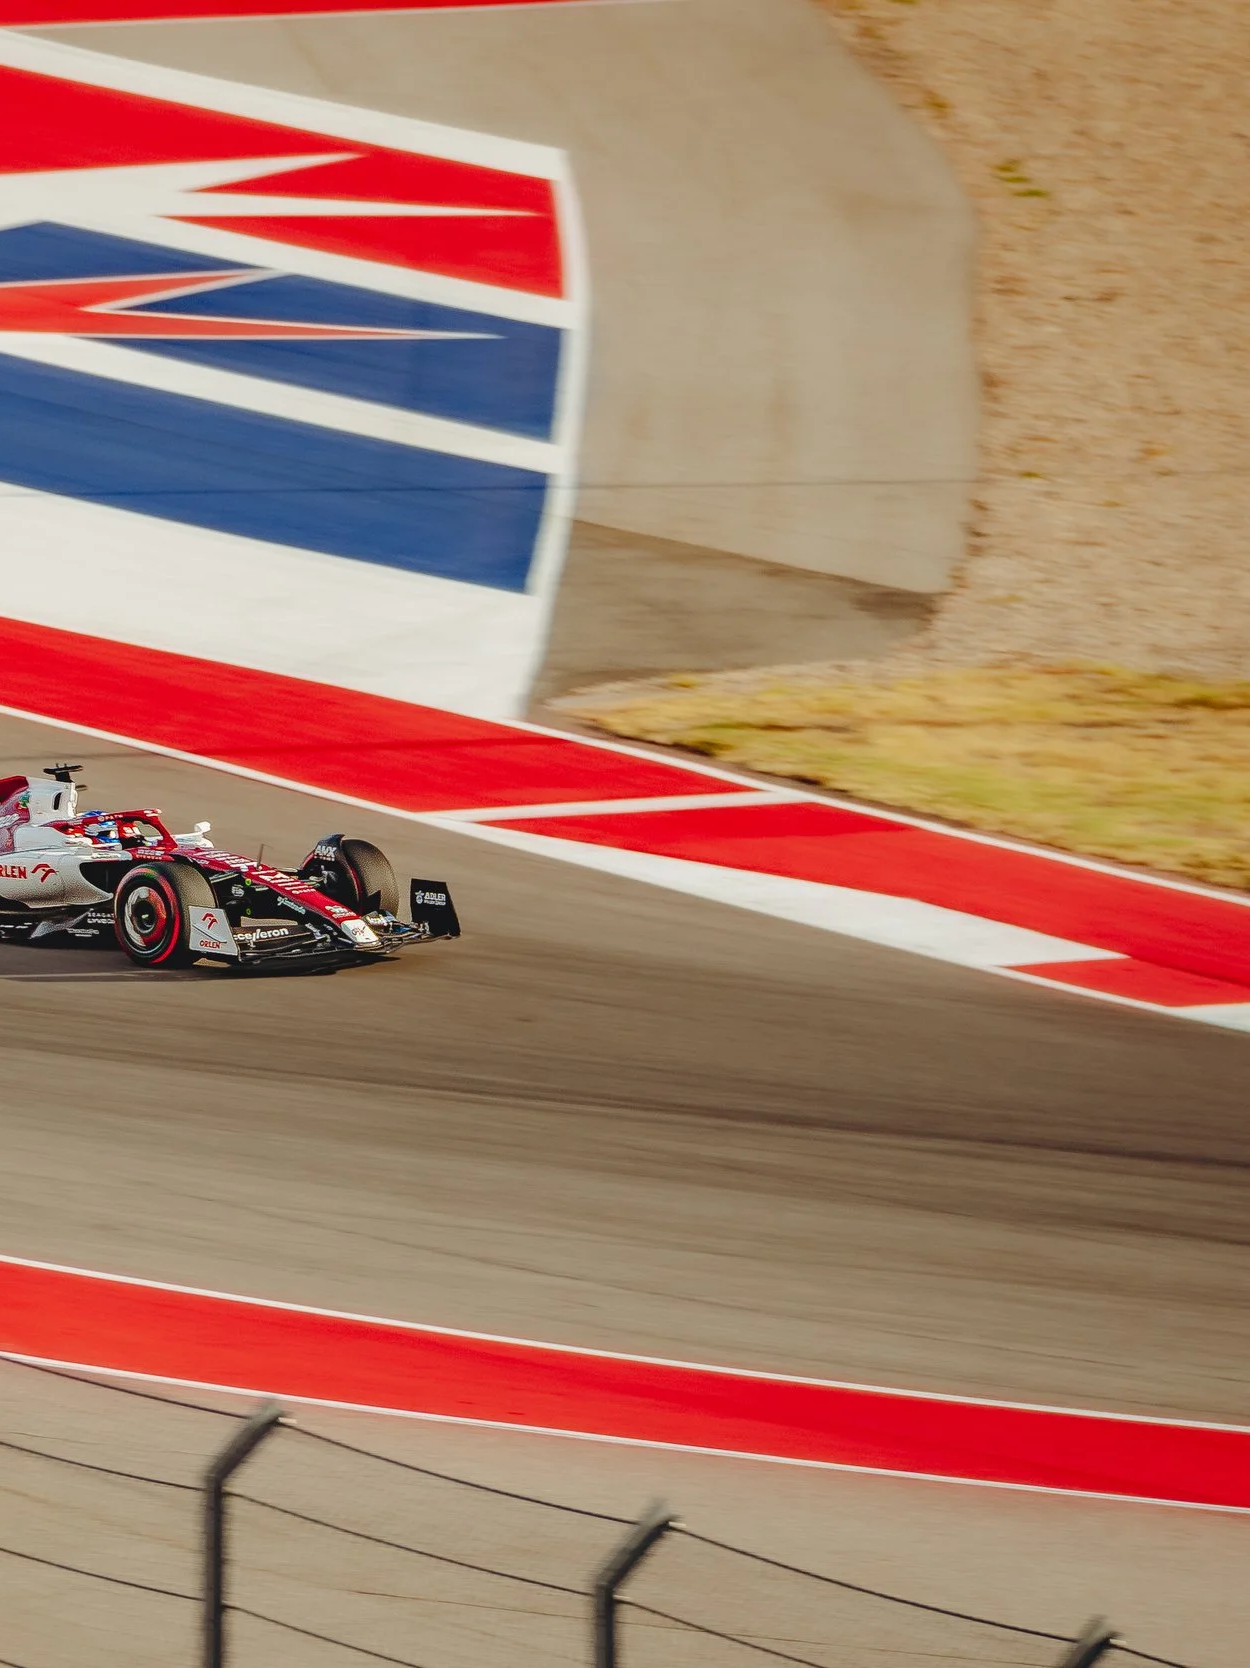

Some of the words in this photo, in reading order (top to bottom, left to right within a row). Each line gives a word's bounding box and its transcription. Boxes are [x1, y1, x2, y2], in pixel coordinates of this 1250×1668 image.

[424, 892, 446, 901] ADLER
[232, 928, 289, 941] ccelleron
[199, 940, 221, 949] ORLEN
